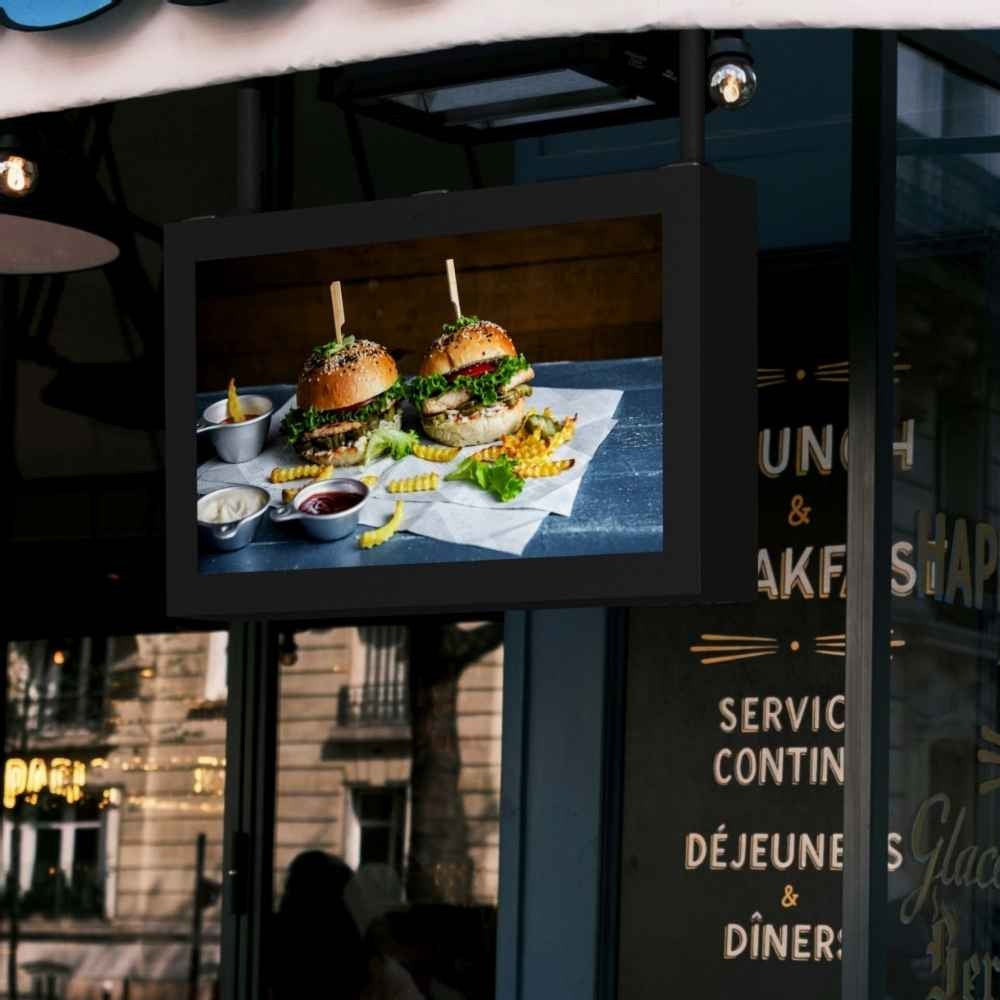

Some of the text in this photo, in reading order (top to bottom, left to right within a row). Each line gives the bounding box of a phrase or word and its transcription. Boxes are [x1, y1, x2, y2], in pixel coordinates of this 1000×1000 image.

[787, 494, 812, 527] &
[718, 694, 847, 733] SERVIC
[713, 745, 846, 786] CONTIN
[684, 822, 904, 872] DÉJEUNES
[781, 884, 800, 908] &
